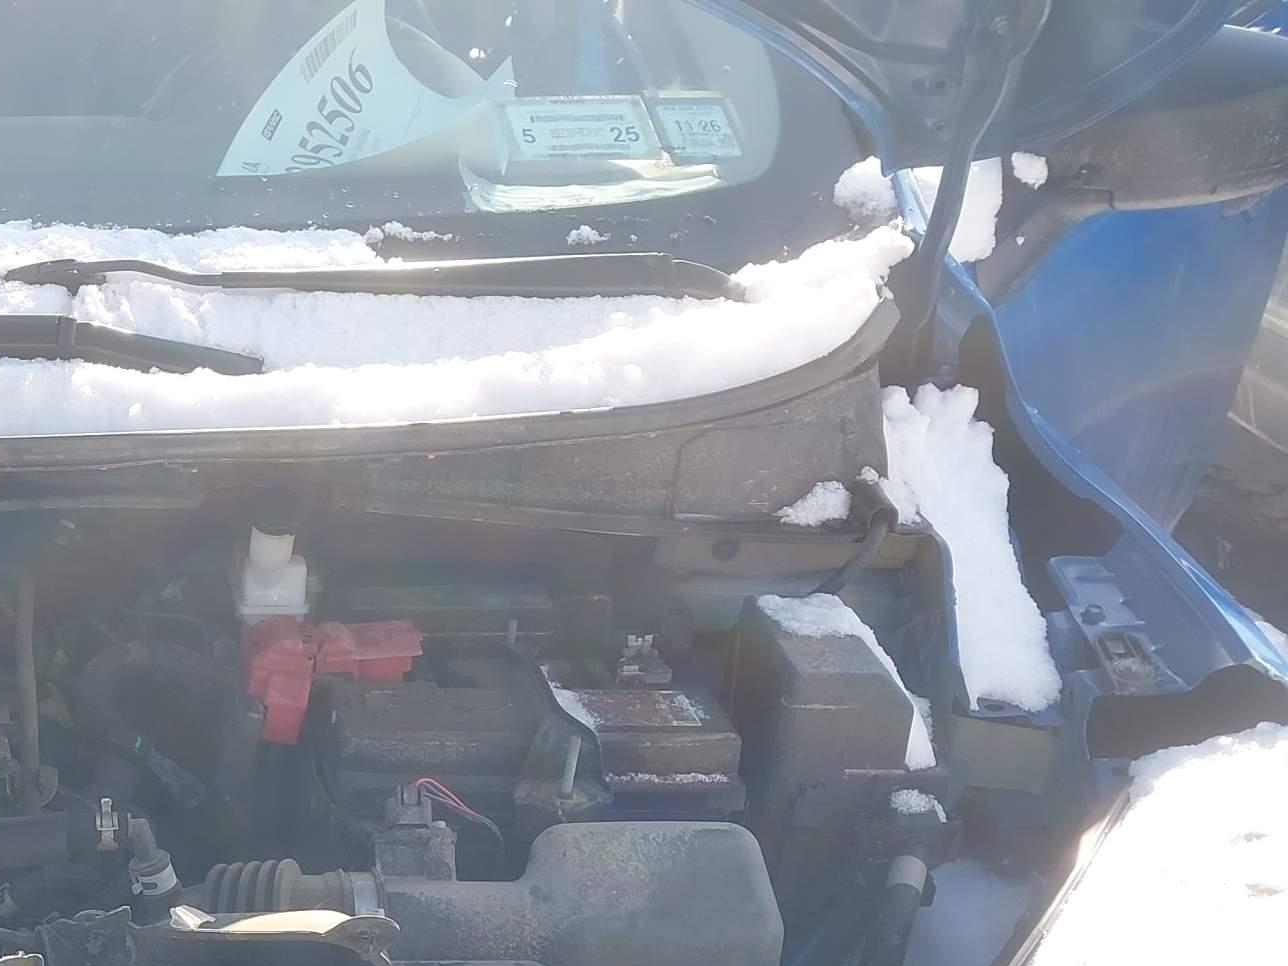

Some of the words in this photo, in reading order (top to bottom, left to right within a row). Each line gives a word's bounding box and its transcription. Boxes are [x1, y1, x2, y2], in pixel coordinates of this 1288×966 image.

[672, 119, 694, 132] 11
[699, 119, 722, 132] 26
[522, 128, 536, 143] 5
[610, 126, 640, 142] 25
